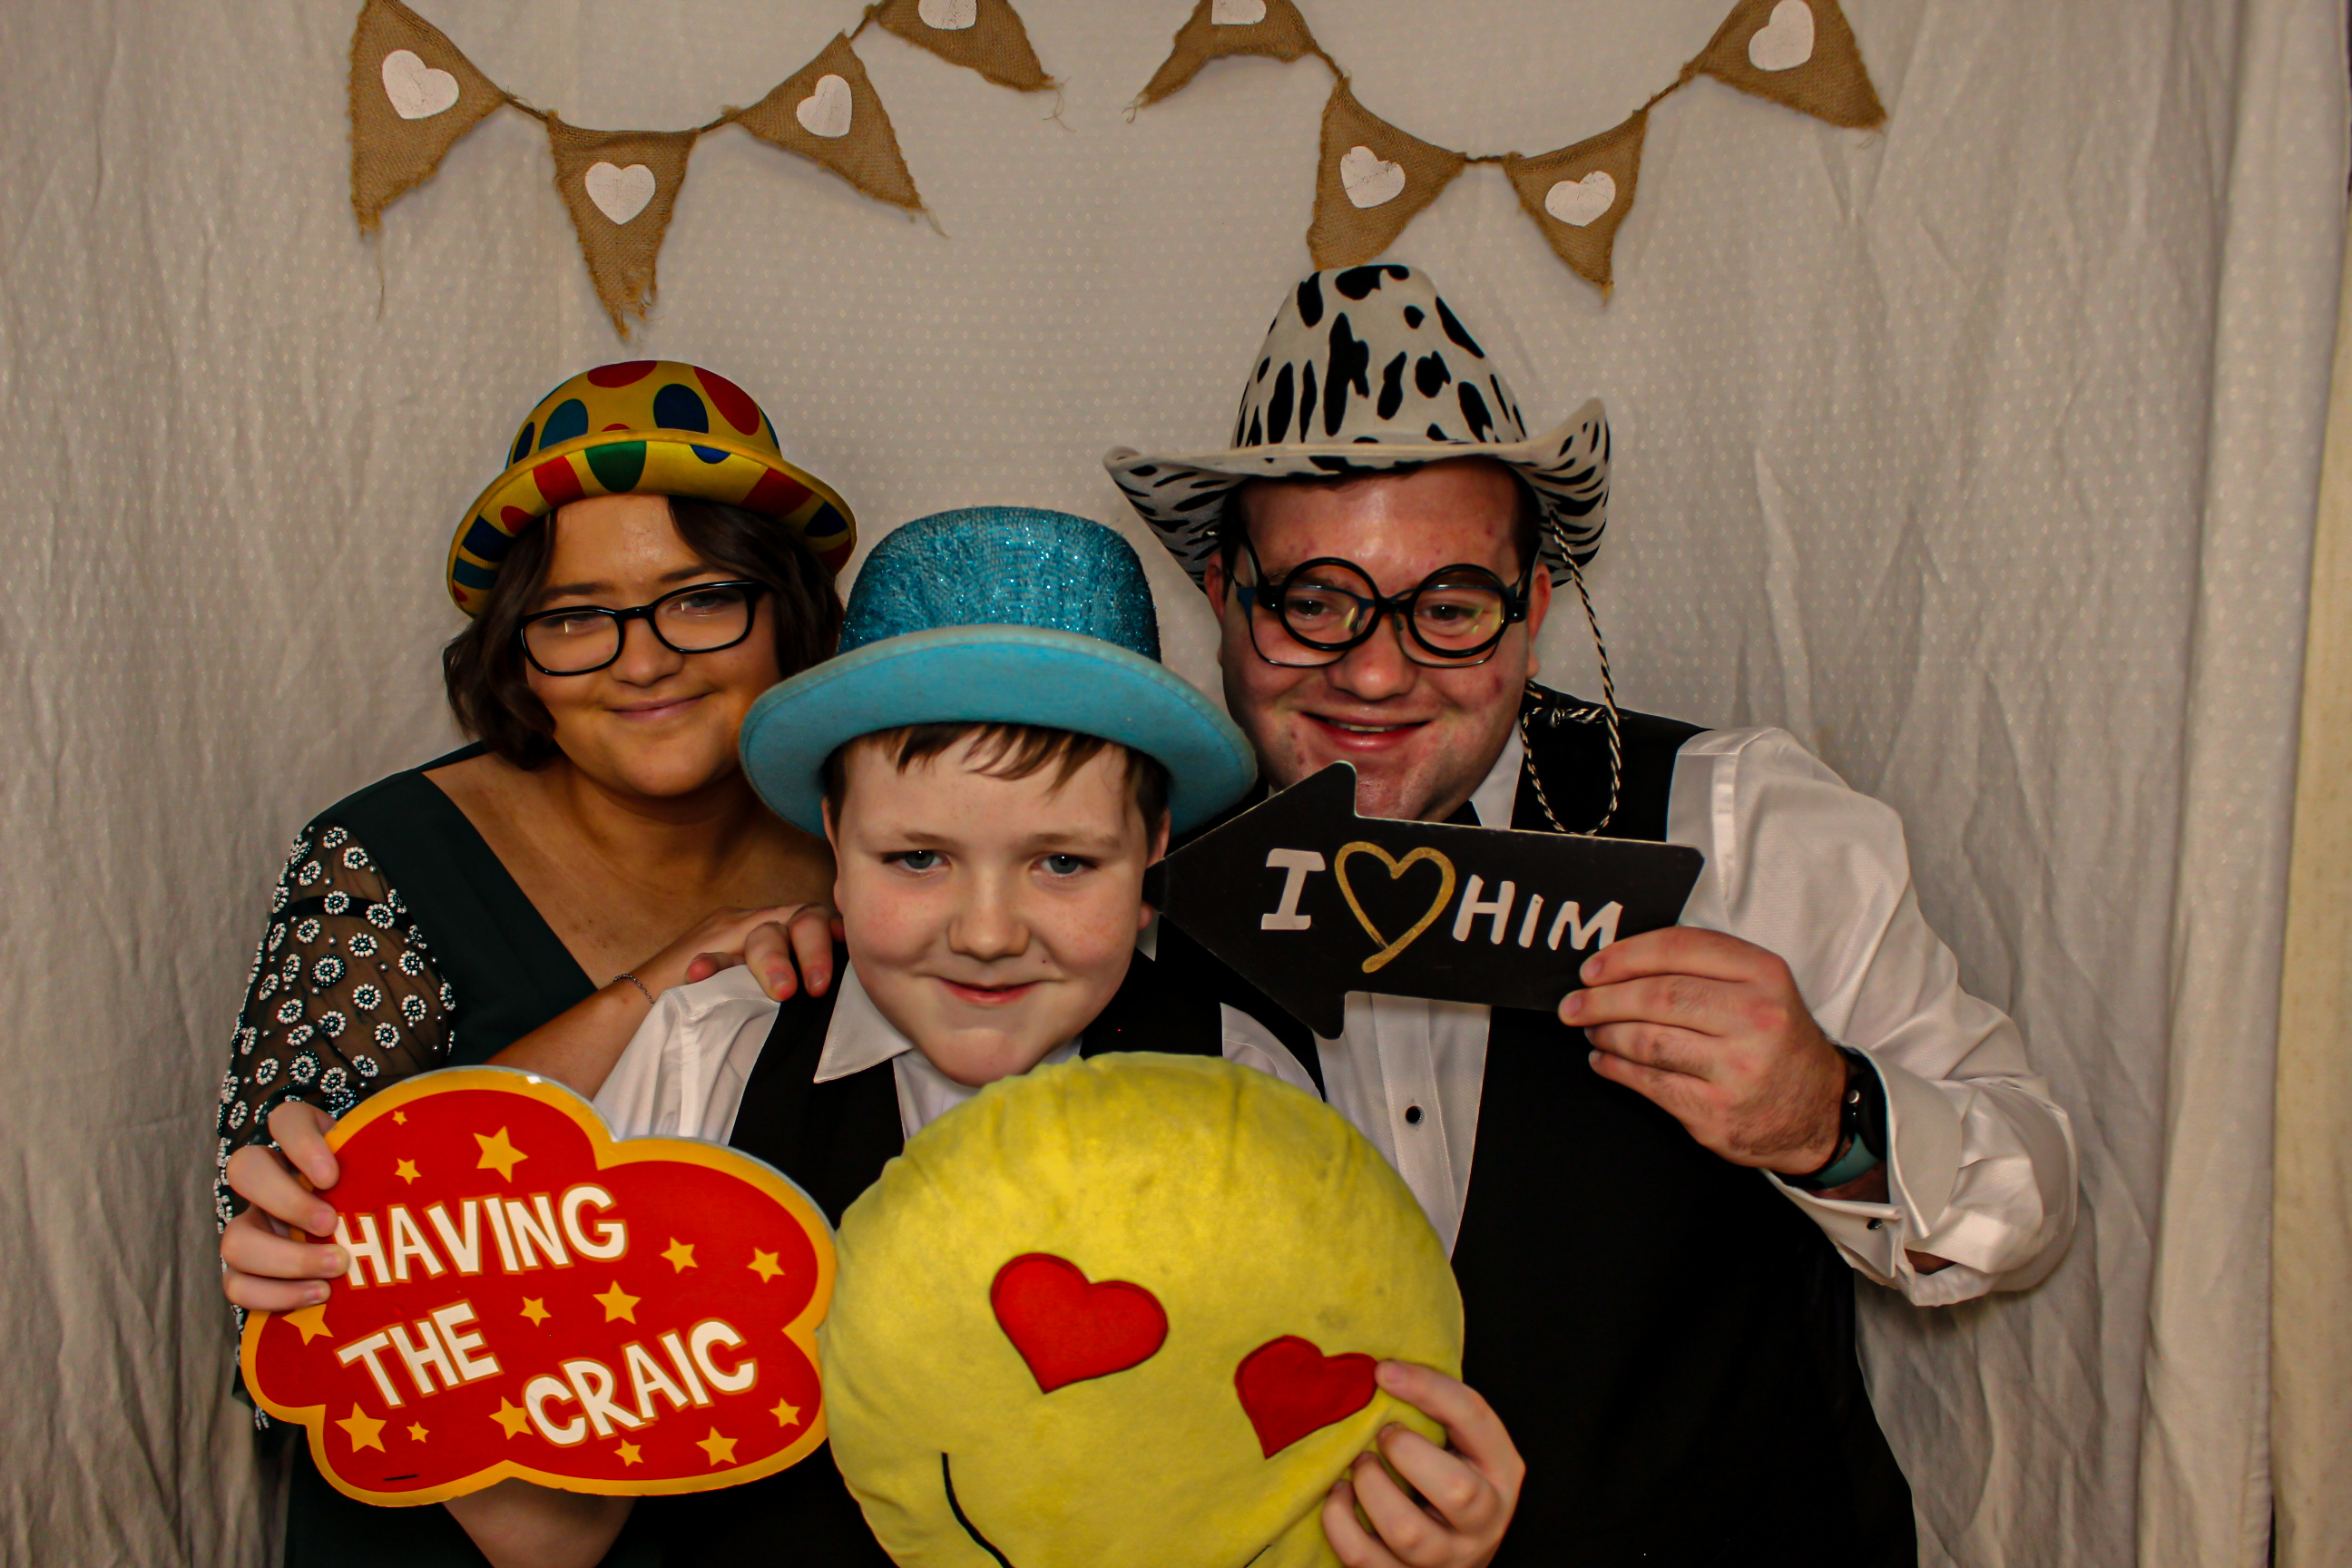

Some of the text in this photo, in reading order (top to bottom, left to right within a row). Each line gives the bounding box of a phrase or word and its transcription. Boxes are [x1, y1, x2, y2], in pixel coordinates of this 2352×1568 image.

[1260, 848, 1623, 951] I HIM
[334, 1184, 627, 1287] HAVING
[338, 1301, 501, 1407] THE
[524, 1320, 756, 1446] CRAIC
